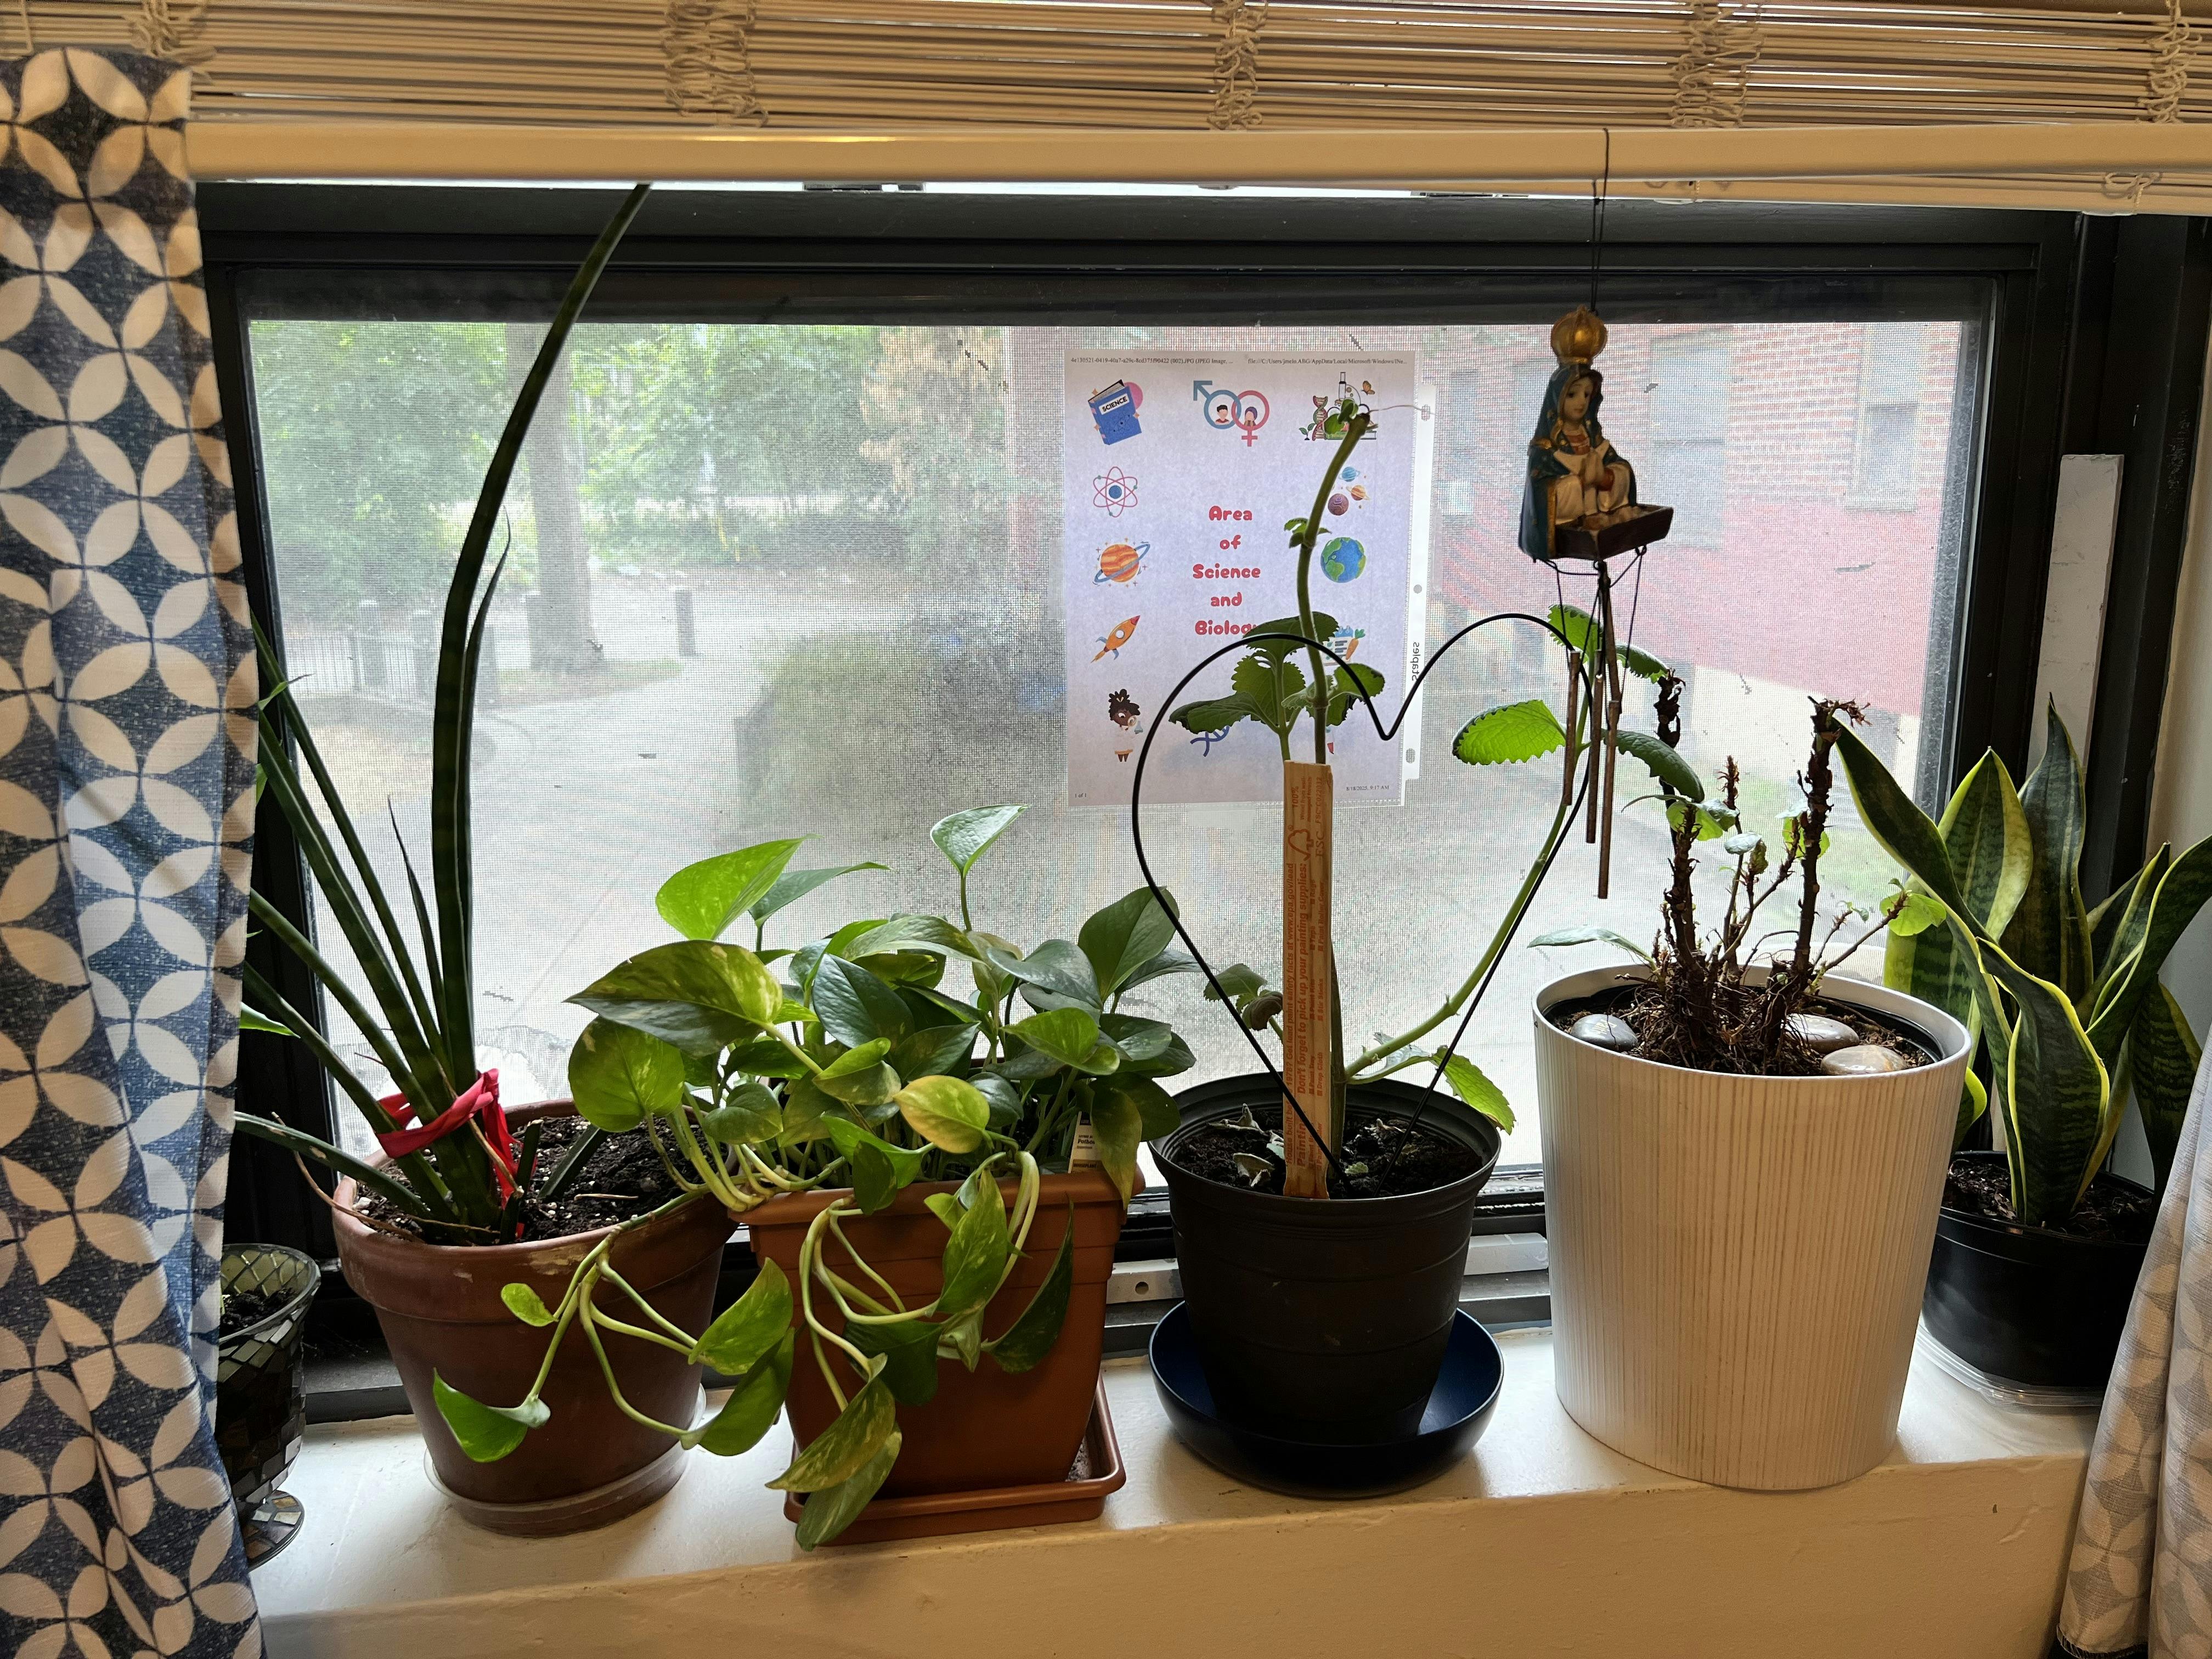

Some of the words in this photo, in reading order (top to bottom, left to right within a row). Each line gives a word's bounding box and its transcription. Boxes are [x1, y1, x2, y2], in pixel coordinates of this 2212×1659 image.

[1102, 396, 1127, 412] SCIENCE
[1208, 505, 1253, 521] Area
[1219, 534, 1241, 550] of
[1192, 562, 1261, 579] Science
[1210, 591, 1243, 607] and
[1195, 619, 1257, 635] Biolog
[1291, 786, 1299, 808] 100%
[1316, 831, 1325, 857] FSC
[1297, 863, 1308, 910] supplies:
[1286, 863, 1295, 940] www.epa.gov/lead
[1297, 912, 1308, 956] painting
[1286, 942, 1293, 951] at
[1299, 956, 1308, 980] your
[1286, 975, 1295, 1001] safety
[1299, 982, 1308, 996] up
[1286, 1003, 1295, 1024] paint
[1297, 997, 1308, 1020] pick
[1297, 1022, 1306, 1033] to
[1297, 1035, 1308, 1066] forget
[1297, 1068, 1306, 1094] Don't
